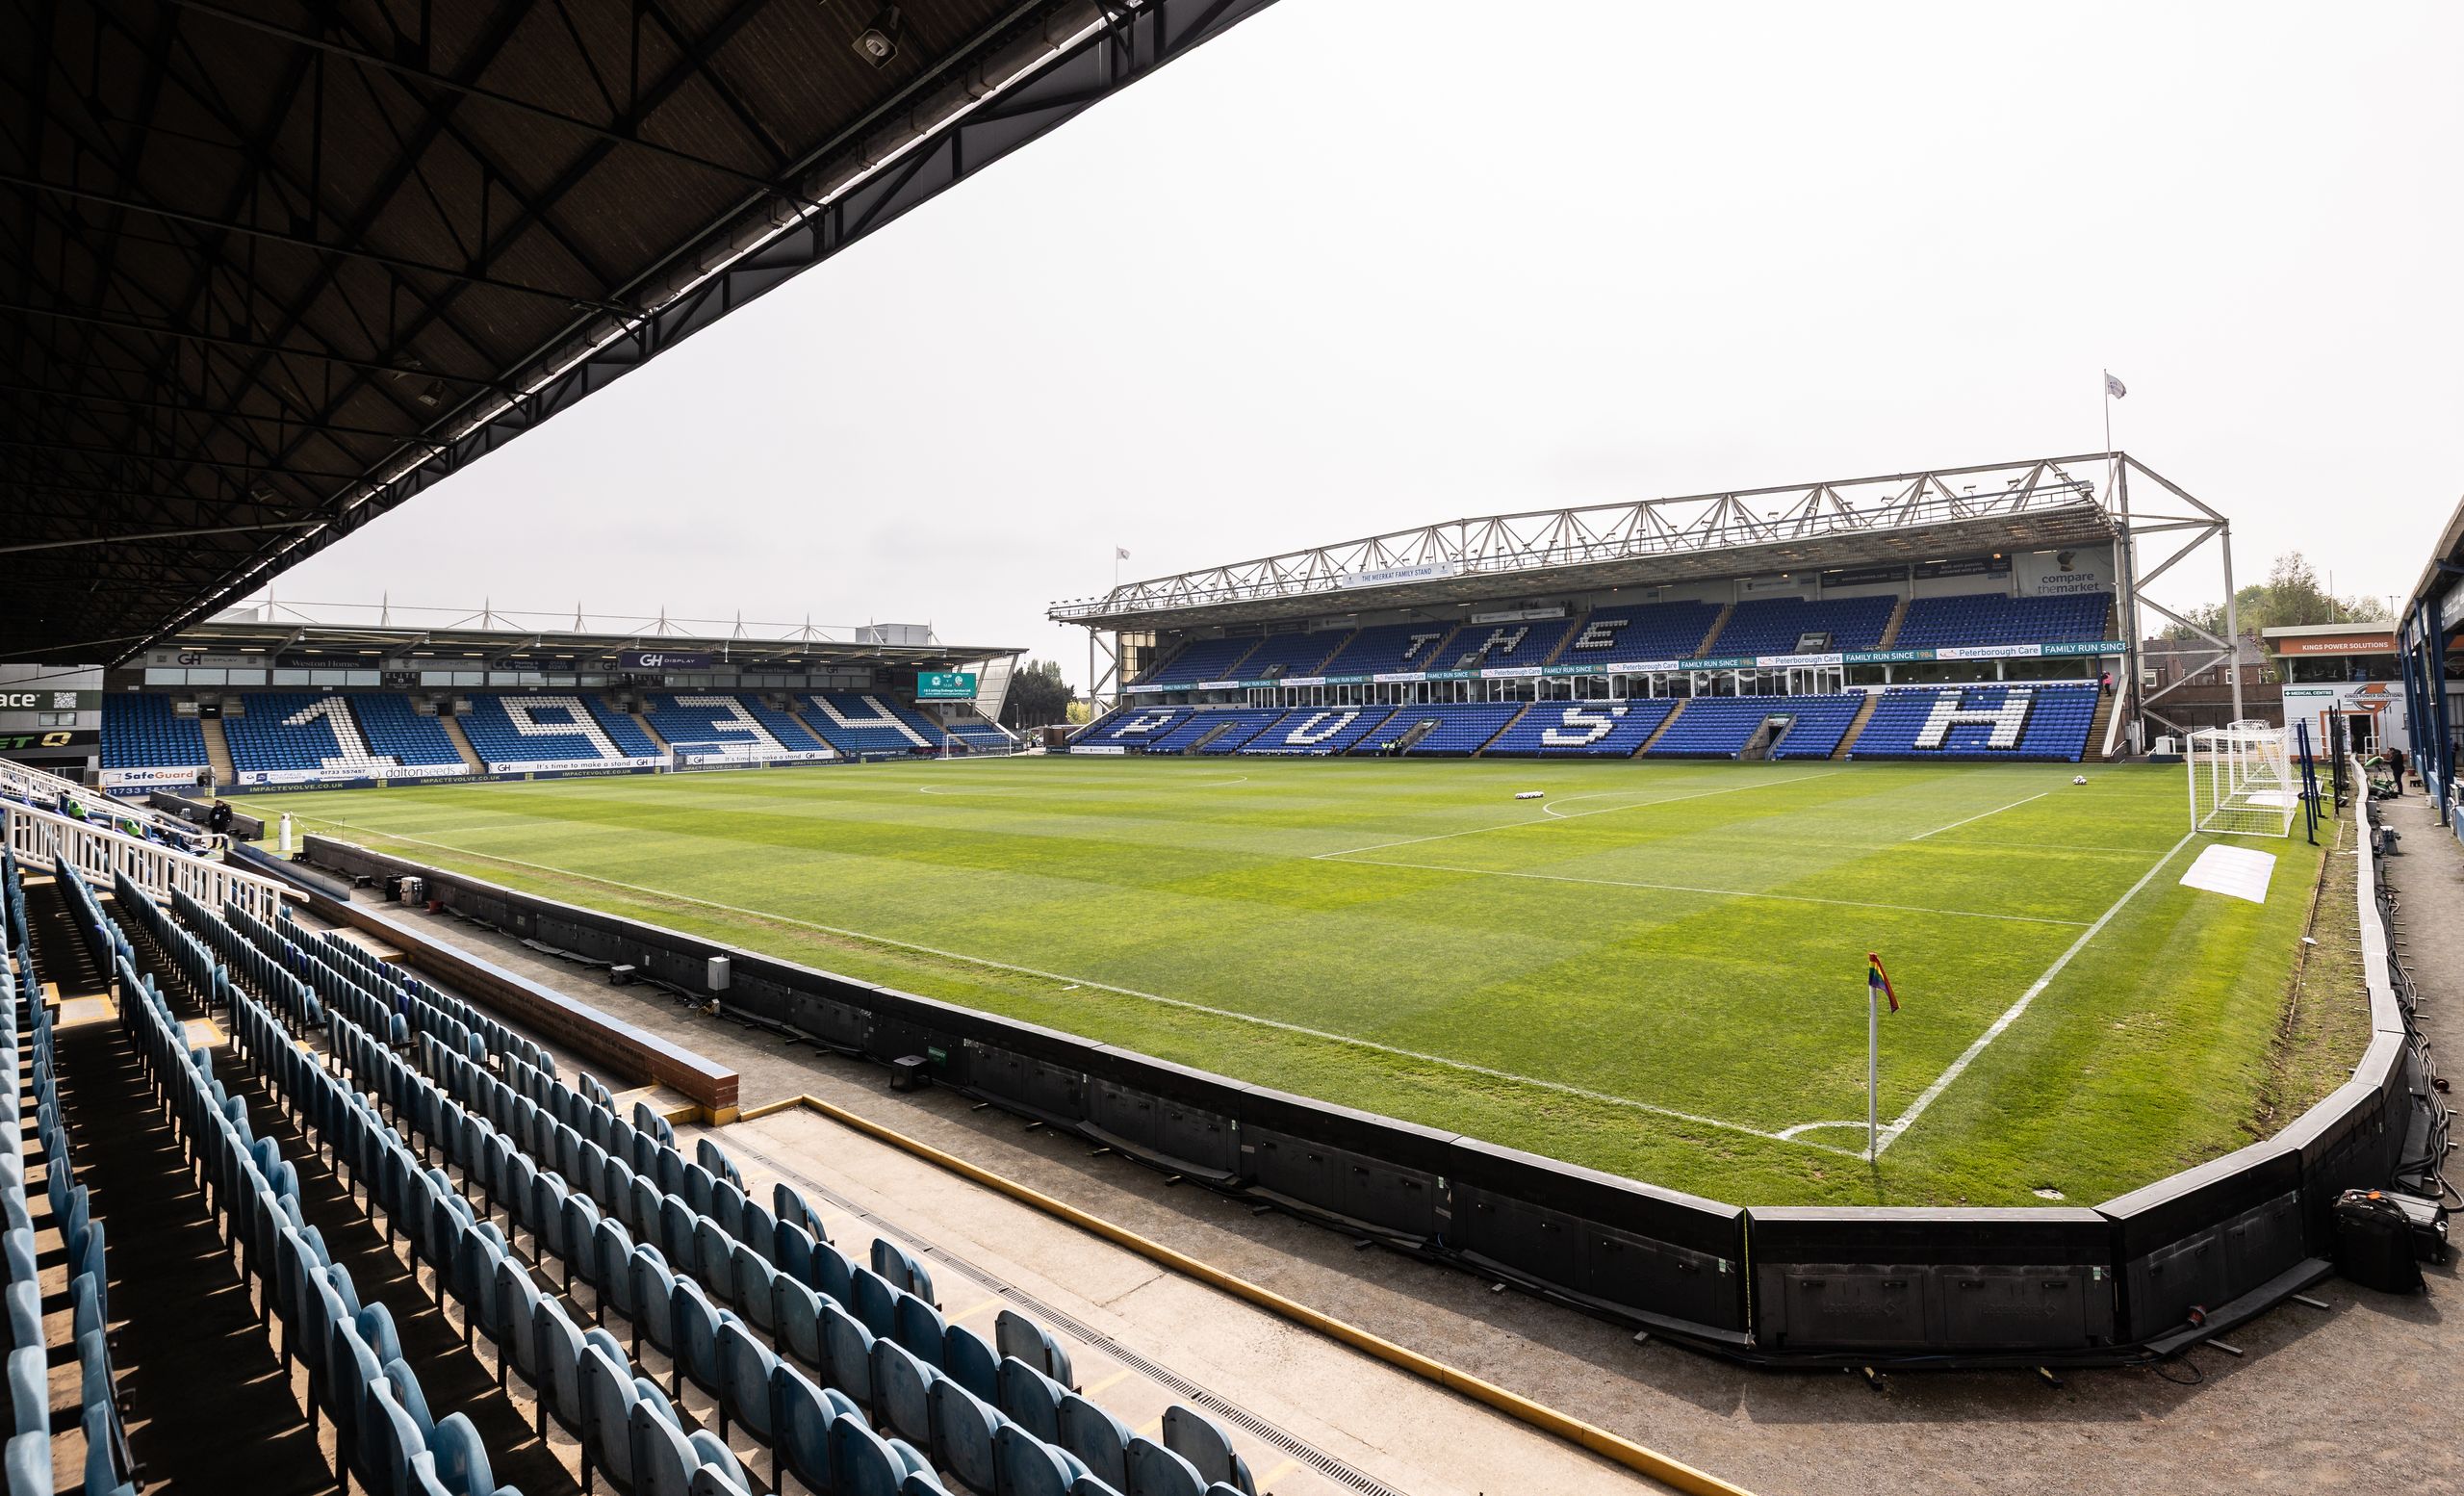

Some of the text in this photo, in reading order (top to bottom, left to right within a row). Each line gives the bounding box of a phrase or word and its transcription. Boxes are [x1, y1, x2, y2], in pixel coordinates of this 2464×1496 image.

[2041, 573, 2094, 584] compare
[2038, 582, 2100, 594] themarket
[1959, 646, 2039, 657] Peterborough Care
[2044, 642, 2126, 654] FAMILY RUN SINCE
[178, 655, 202, 666] GH
[639, 655, 663, 666] GH
[1775, 657, 1823, 665] Peterborough
[1846, 653, 1873, 661] FAMILY
[124, 770, 193, 780] SafeGuard
[385, 766, 456, 778] daltonseeds
[420, 775, 500, 784] IMPACTEVOLVE.CO.UK
[250, 783, 344, 792] IMPACTEVOLVE.CO.UK
